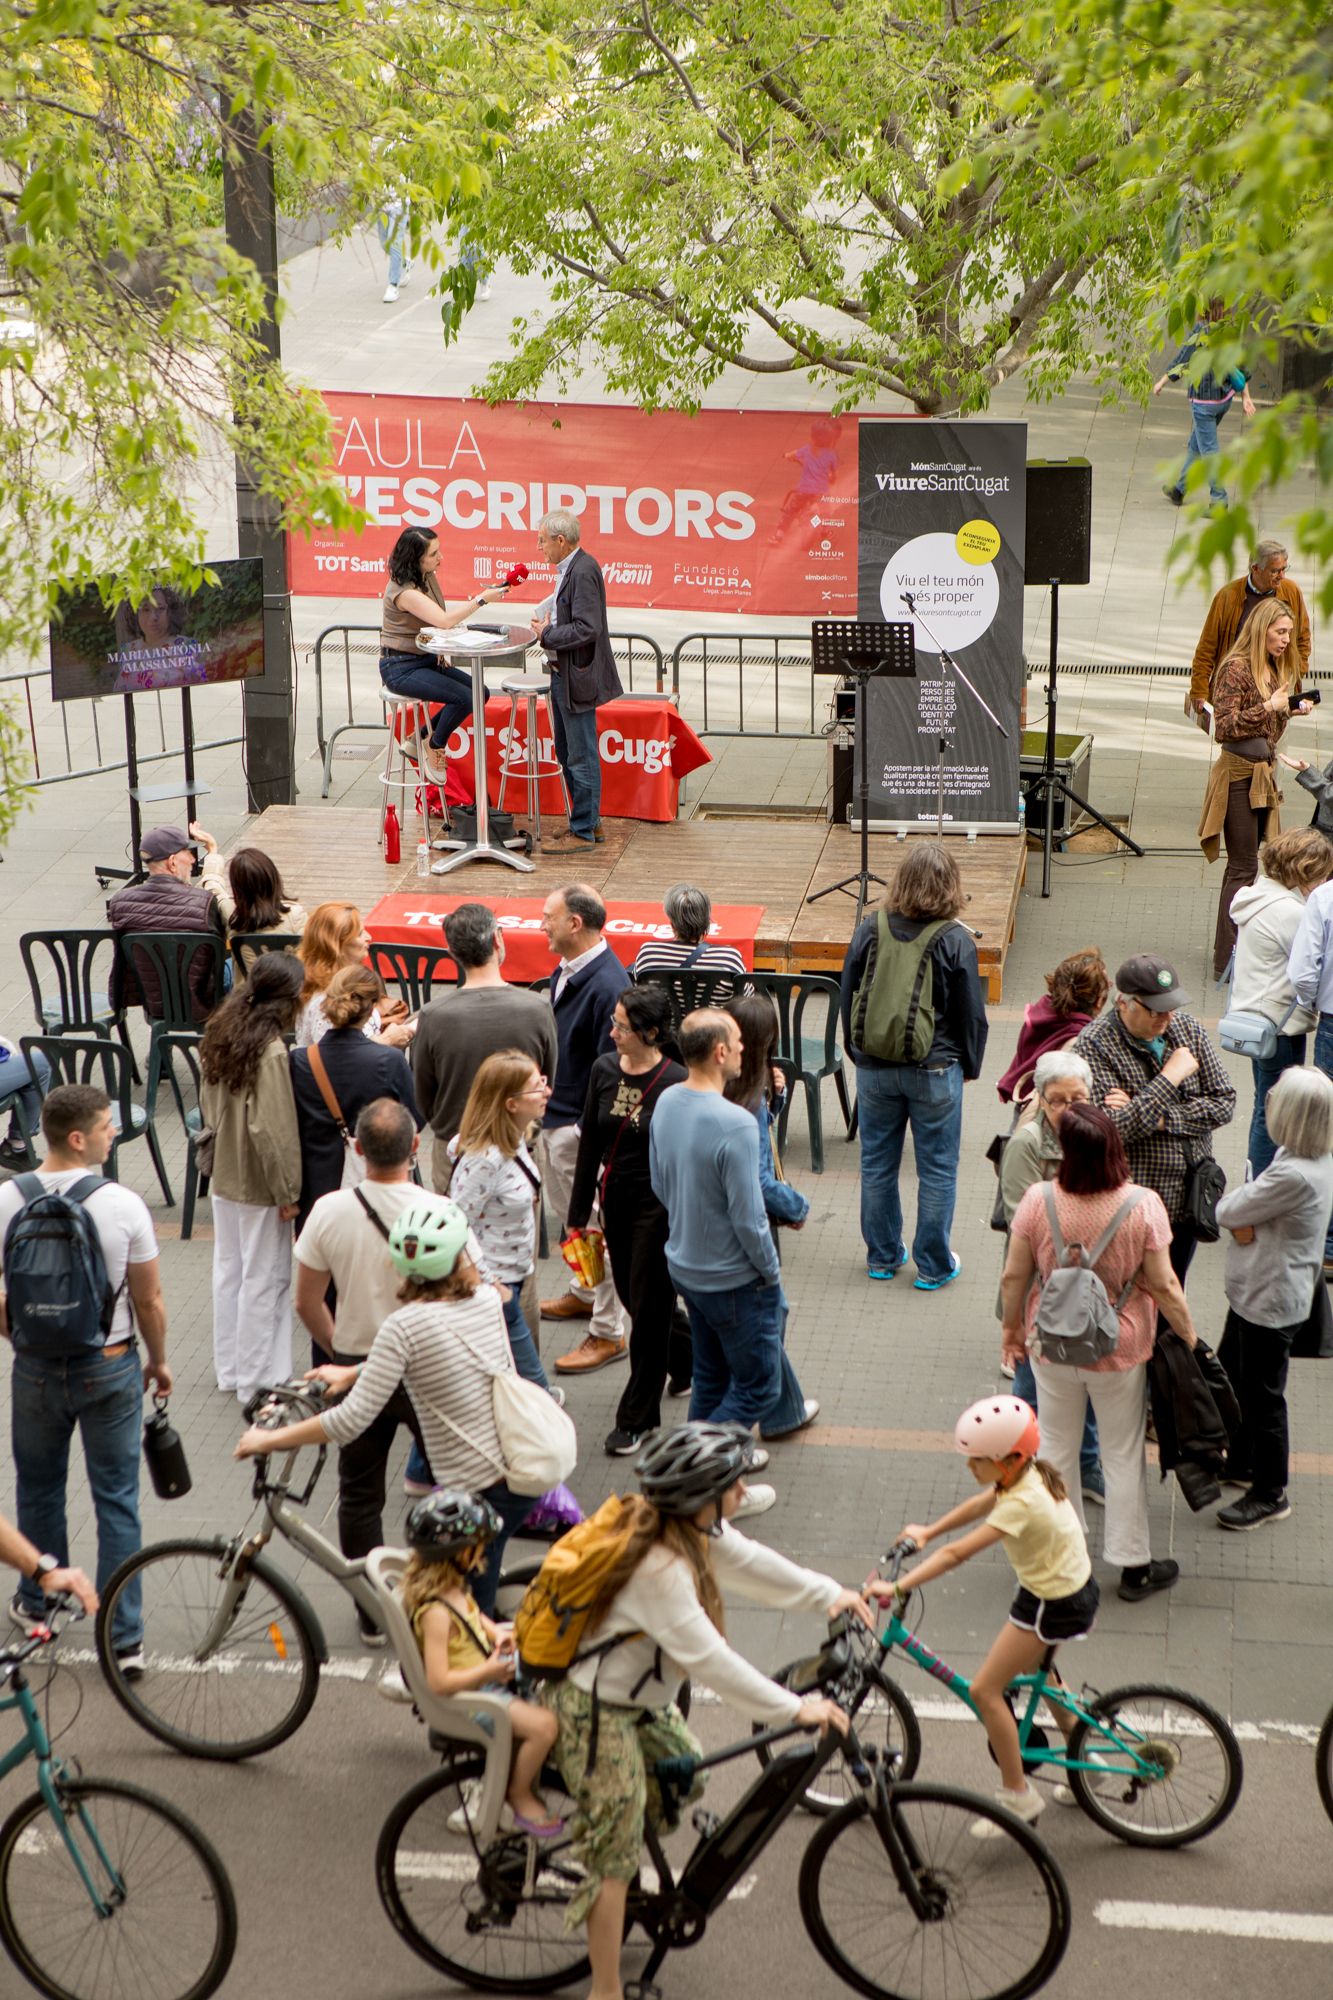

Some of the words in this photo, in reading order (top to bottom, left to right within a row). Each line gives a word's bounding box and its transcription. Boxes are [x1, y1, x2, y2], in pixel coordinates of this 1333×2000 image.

[910, 462, 967, 473] MónSantCugat
[875, 473, 1010, 496] ViureSantCugat
[314, 555, 349, 572] TOT
[350, 556, 385, 573] Sant
[674, 563, 740, 576] Fundació
[674, 575, 752, 588] FLUIDRA
[896, 574, 916, 587] Viu
[919, 574, 930, 587] el
[933, 575, 954, 587] teu
[956, 574, 984, 587] món
[934, 592, 975, 604] proper
[107, 648, 151, 664] MARIA
[122, 655, 194, 673] MASSANET
[884, 764, 912, 772] Apostem
[924, 764, 930, 772] la
[965, 765, 980, 773] local
[883, 773, 907, 781] qualitat
[953, 773, 989, 781] fermament
[954, 780, 991, 788] d'integració
[905, 787, 931, 795] societat
[960, 788, 982, 796] entorn
[605, 916, 722, 940] Cugt
[616, 1085, 643, 1104] RO
